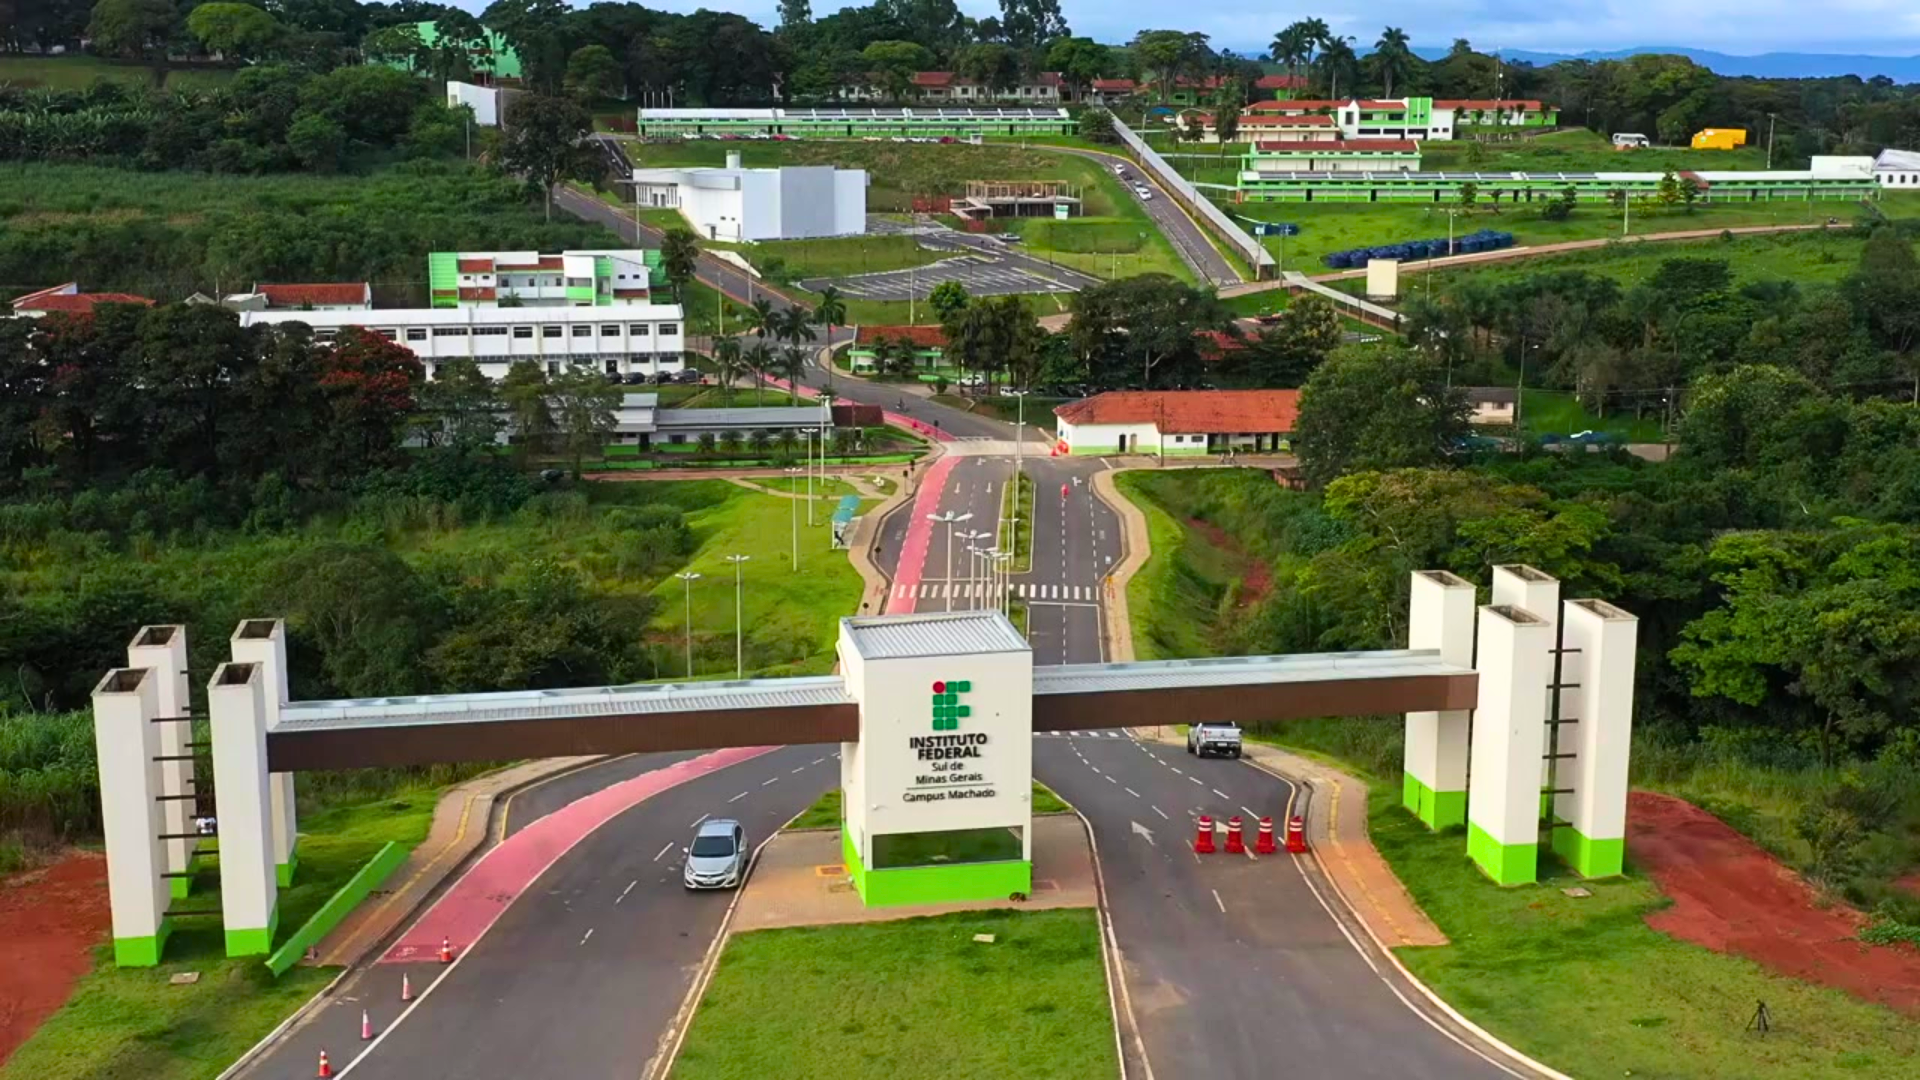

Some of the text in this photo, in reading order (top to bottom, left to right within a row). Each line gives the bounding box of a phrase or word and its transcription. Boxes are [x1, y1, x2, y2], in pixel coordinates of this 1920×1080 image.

[909, 733, 988, 749] INSTITUTO
[917, 746, 982, 760] FEDERAL
[931, 761, 964, 772] Sul de
[915, 772, 983, 785] Minas Gerais
[902, 787, 996, 803] Campus Machado
